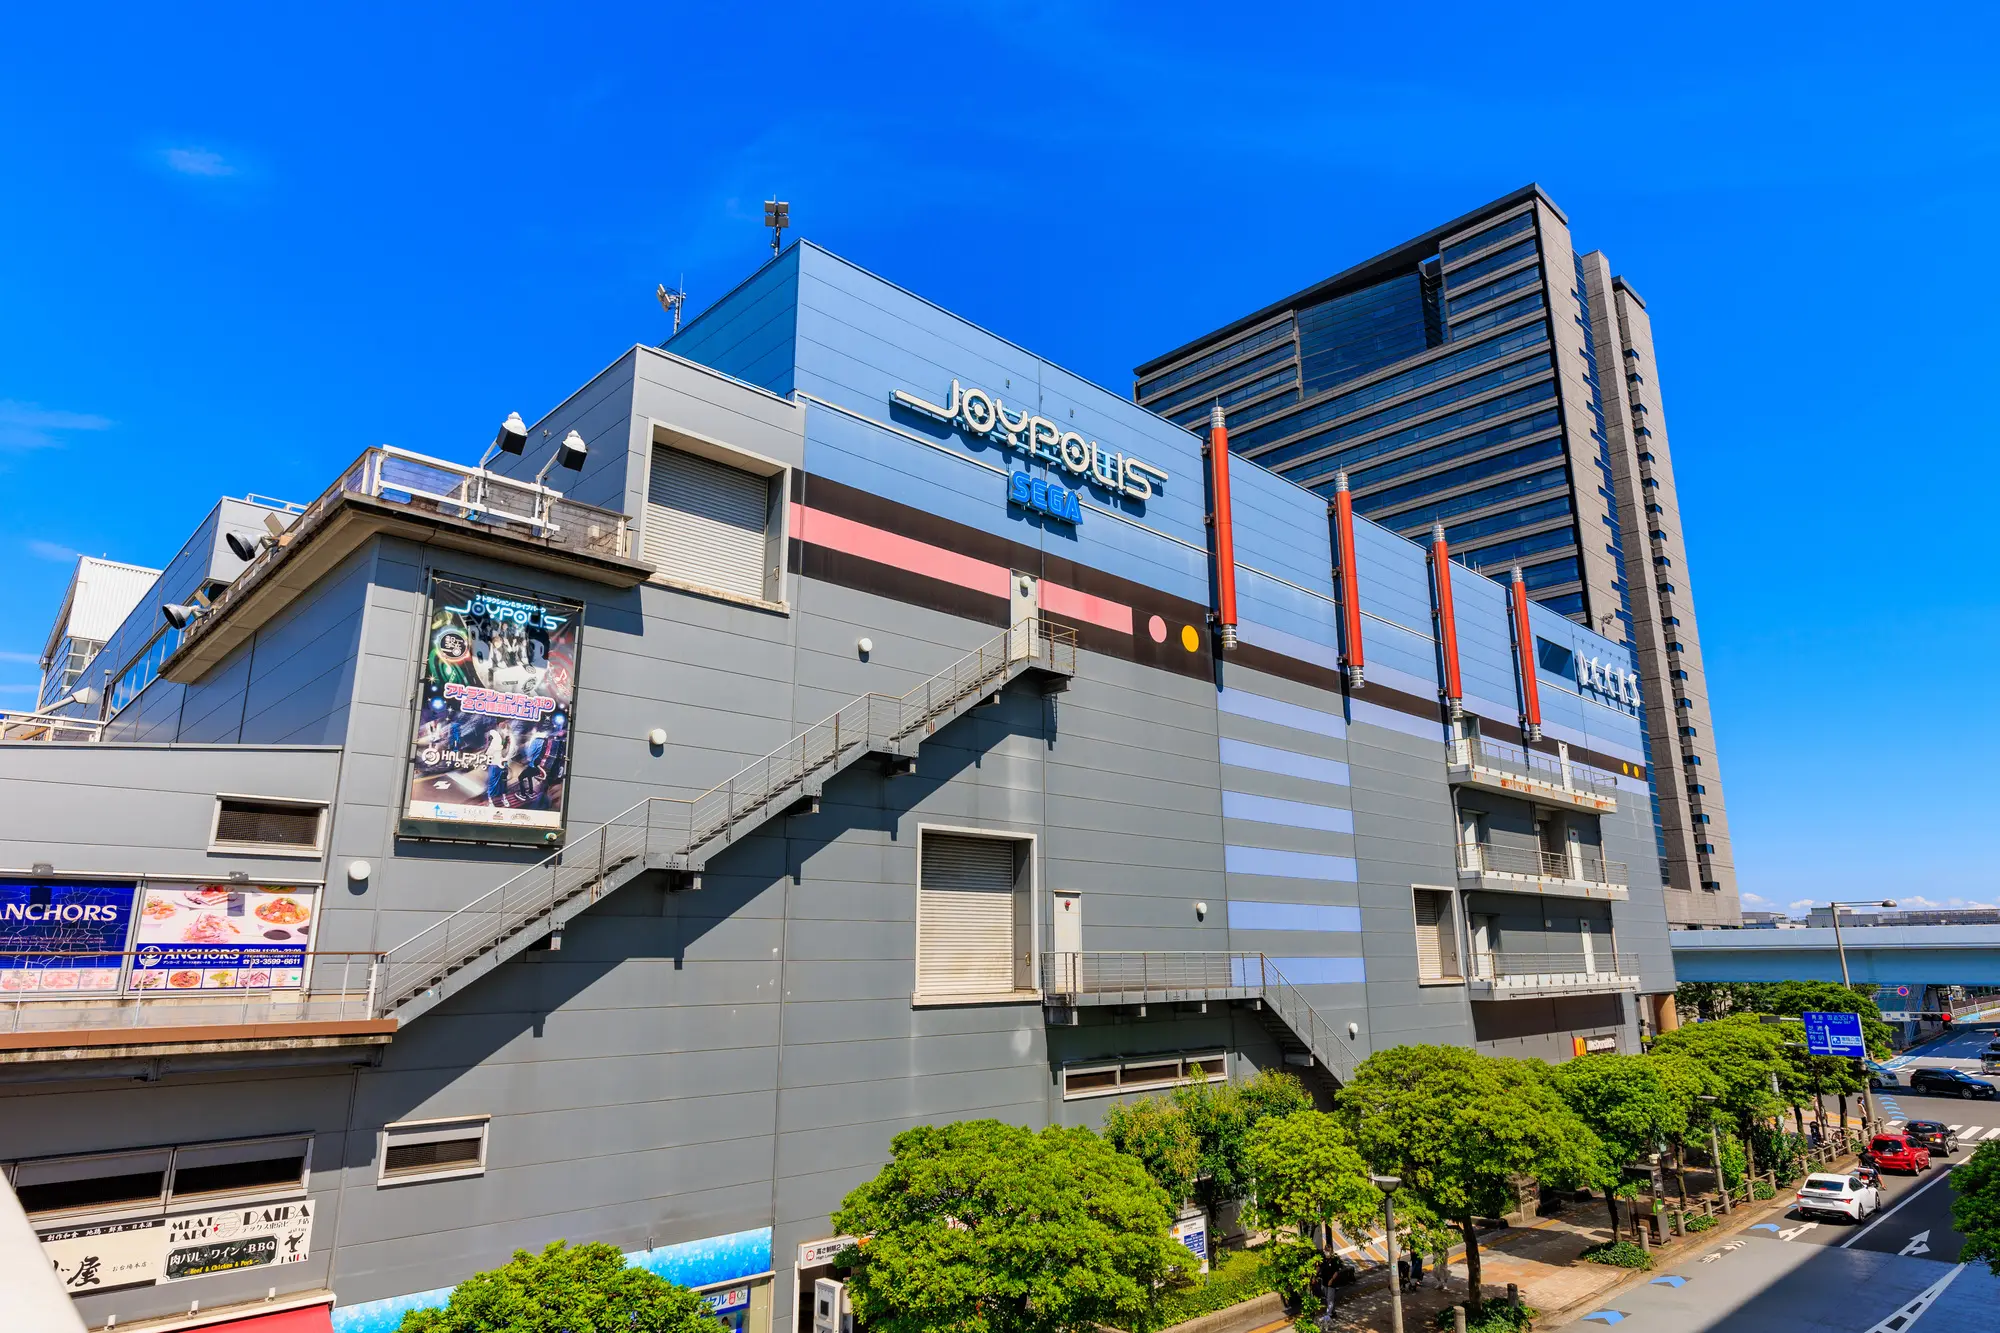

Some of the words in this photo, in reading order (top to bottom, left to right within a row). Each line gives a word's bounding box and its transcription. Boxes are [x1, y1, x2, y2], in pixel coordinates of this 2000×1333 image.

[893, 378, 1169, 500] JOYPOLIS
[1009, 471, 1084, 525] SEGA
[444, 599, 568, 631] JOYPOLIS
[445, 684, 556, 711] アトラクションたっぷり
[441, 750, 494, 765] HALFPIPE
[445, 761, 488, 771] TOKYO
[163, 948, 240, 960] ANCHORS
[243, 1204, 311, 1226] DAIBA
[170, 1217, 213, 1232] MEAT
[169, 1228, 213, 1243] LABO
